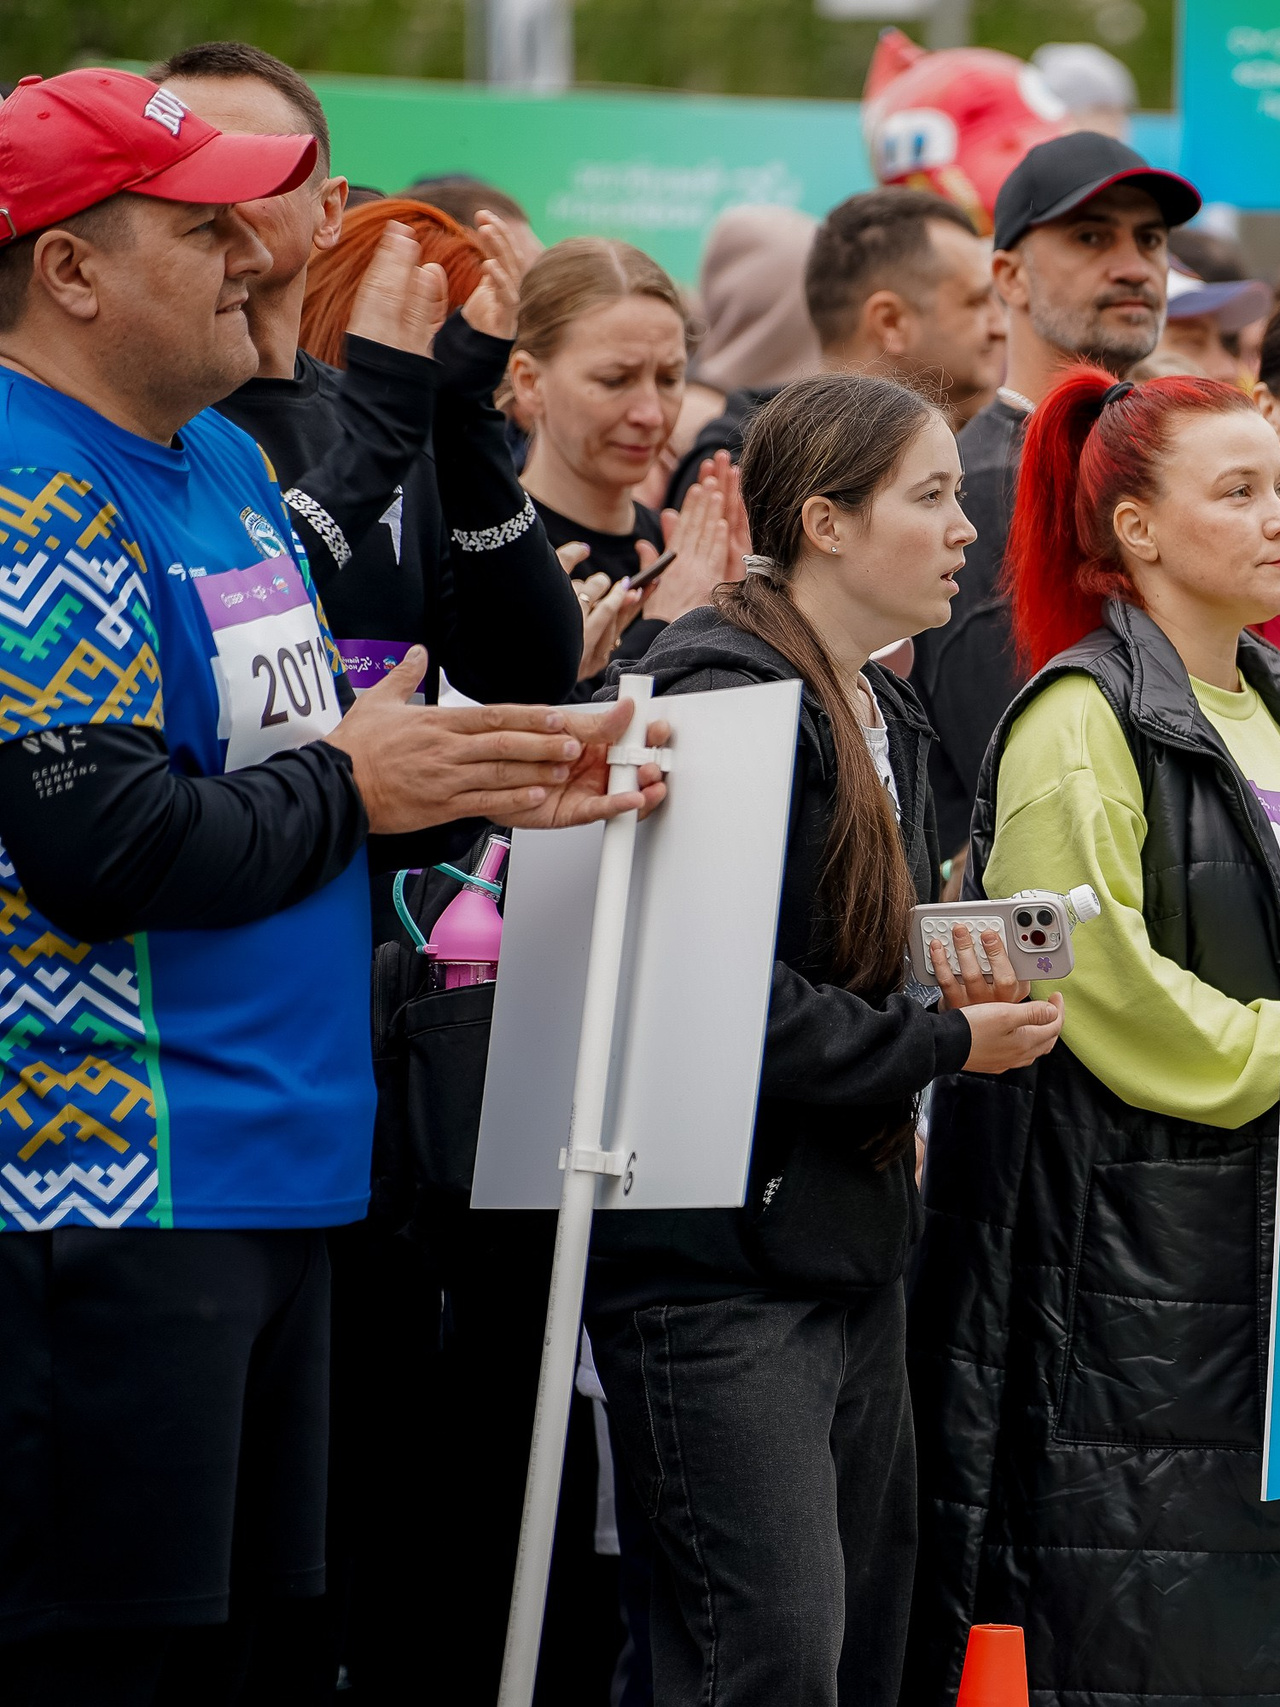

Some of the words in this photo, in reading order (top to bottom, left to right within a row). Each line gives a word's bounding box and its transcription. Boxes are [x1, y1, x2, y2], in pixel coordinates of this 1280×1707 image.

[32, 760, 74, 781] DEMIX
[35, 764, 98, 790] RUNNING
[39, 780, 75, 799] TEAM
